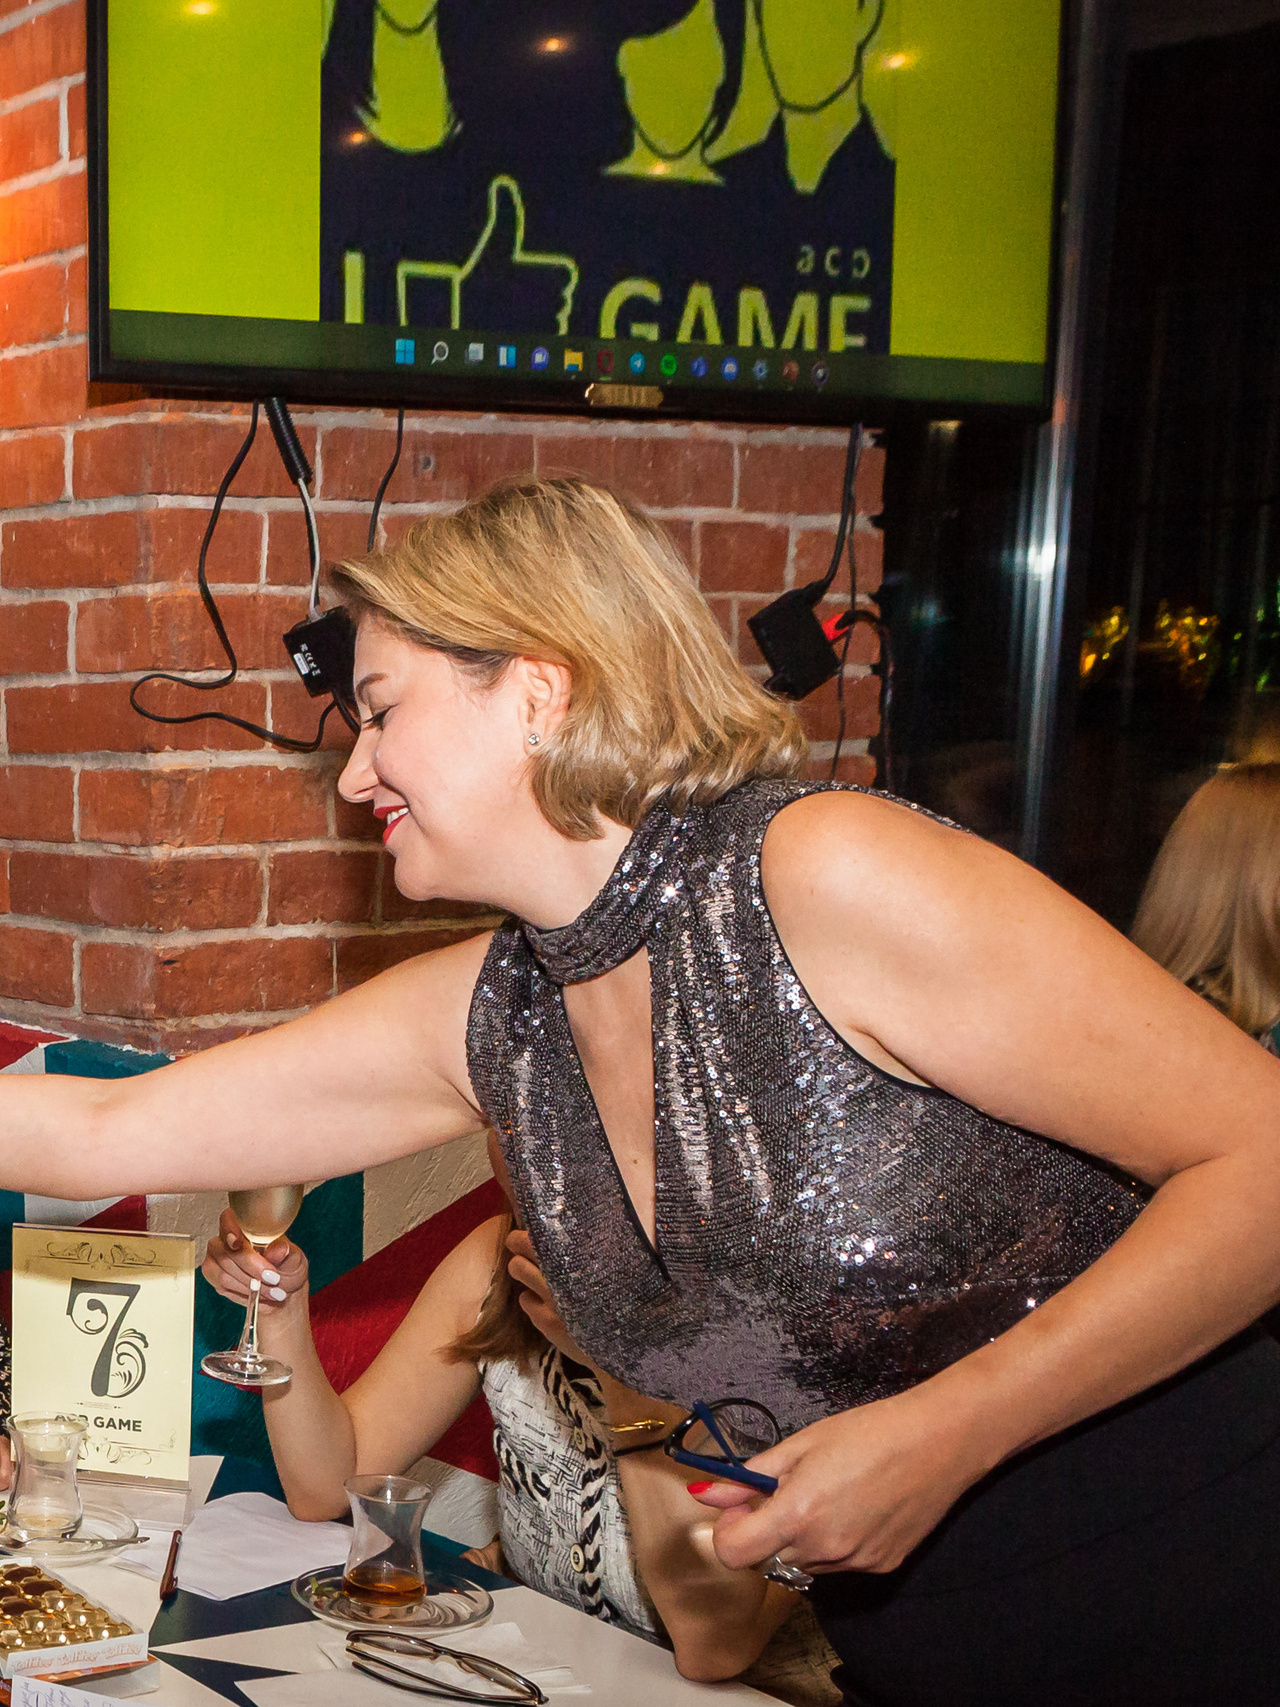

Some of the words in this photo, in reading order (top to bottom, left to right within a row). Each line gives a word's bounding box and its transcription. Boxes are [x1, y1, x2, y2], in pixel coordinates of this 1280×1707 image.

[600, 277, 871, 352] GAME
[66, 1277, 148, 1398] 7
[93, 1416, 142, 1432] GAME
